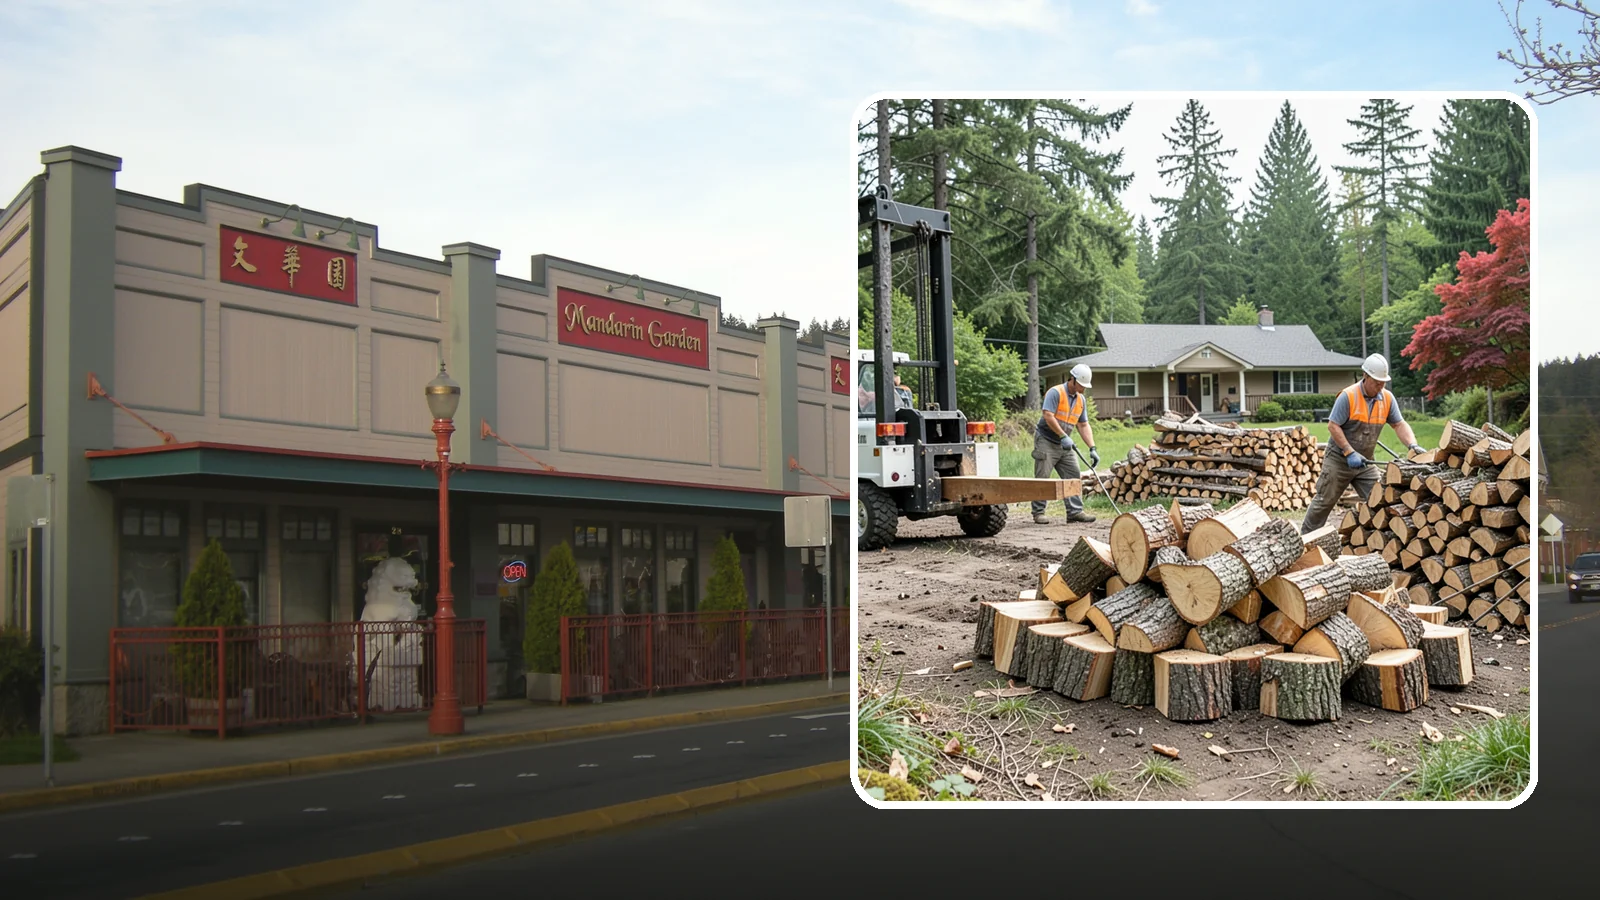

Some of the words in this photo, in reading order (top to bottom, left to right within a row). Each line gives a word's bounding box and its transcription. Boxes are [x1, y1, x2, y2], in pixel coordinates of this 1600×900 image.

[231, 236, 346, 290] 文華園
[564, 302, 644, 340] Mandarin
[647, 320, 702, 351] Garden
[503, 565, 527, 578] OPEN
